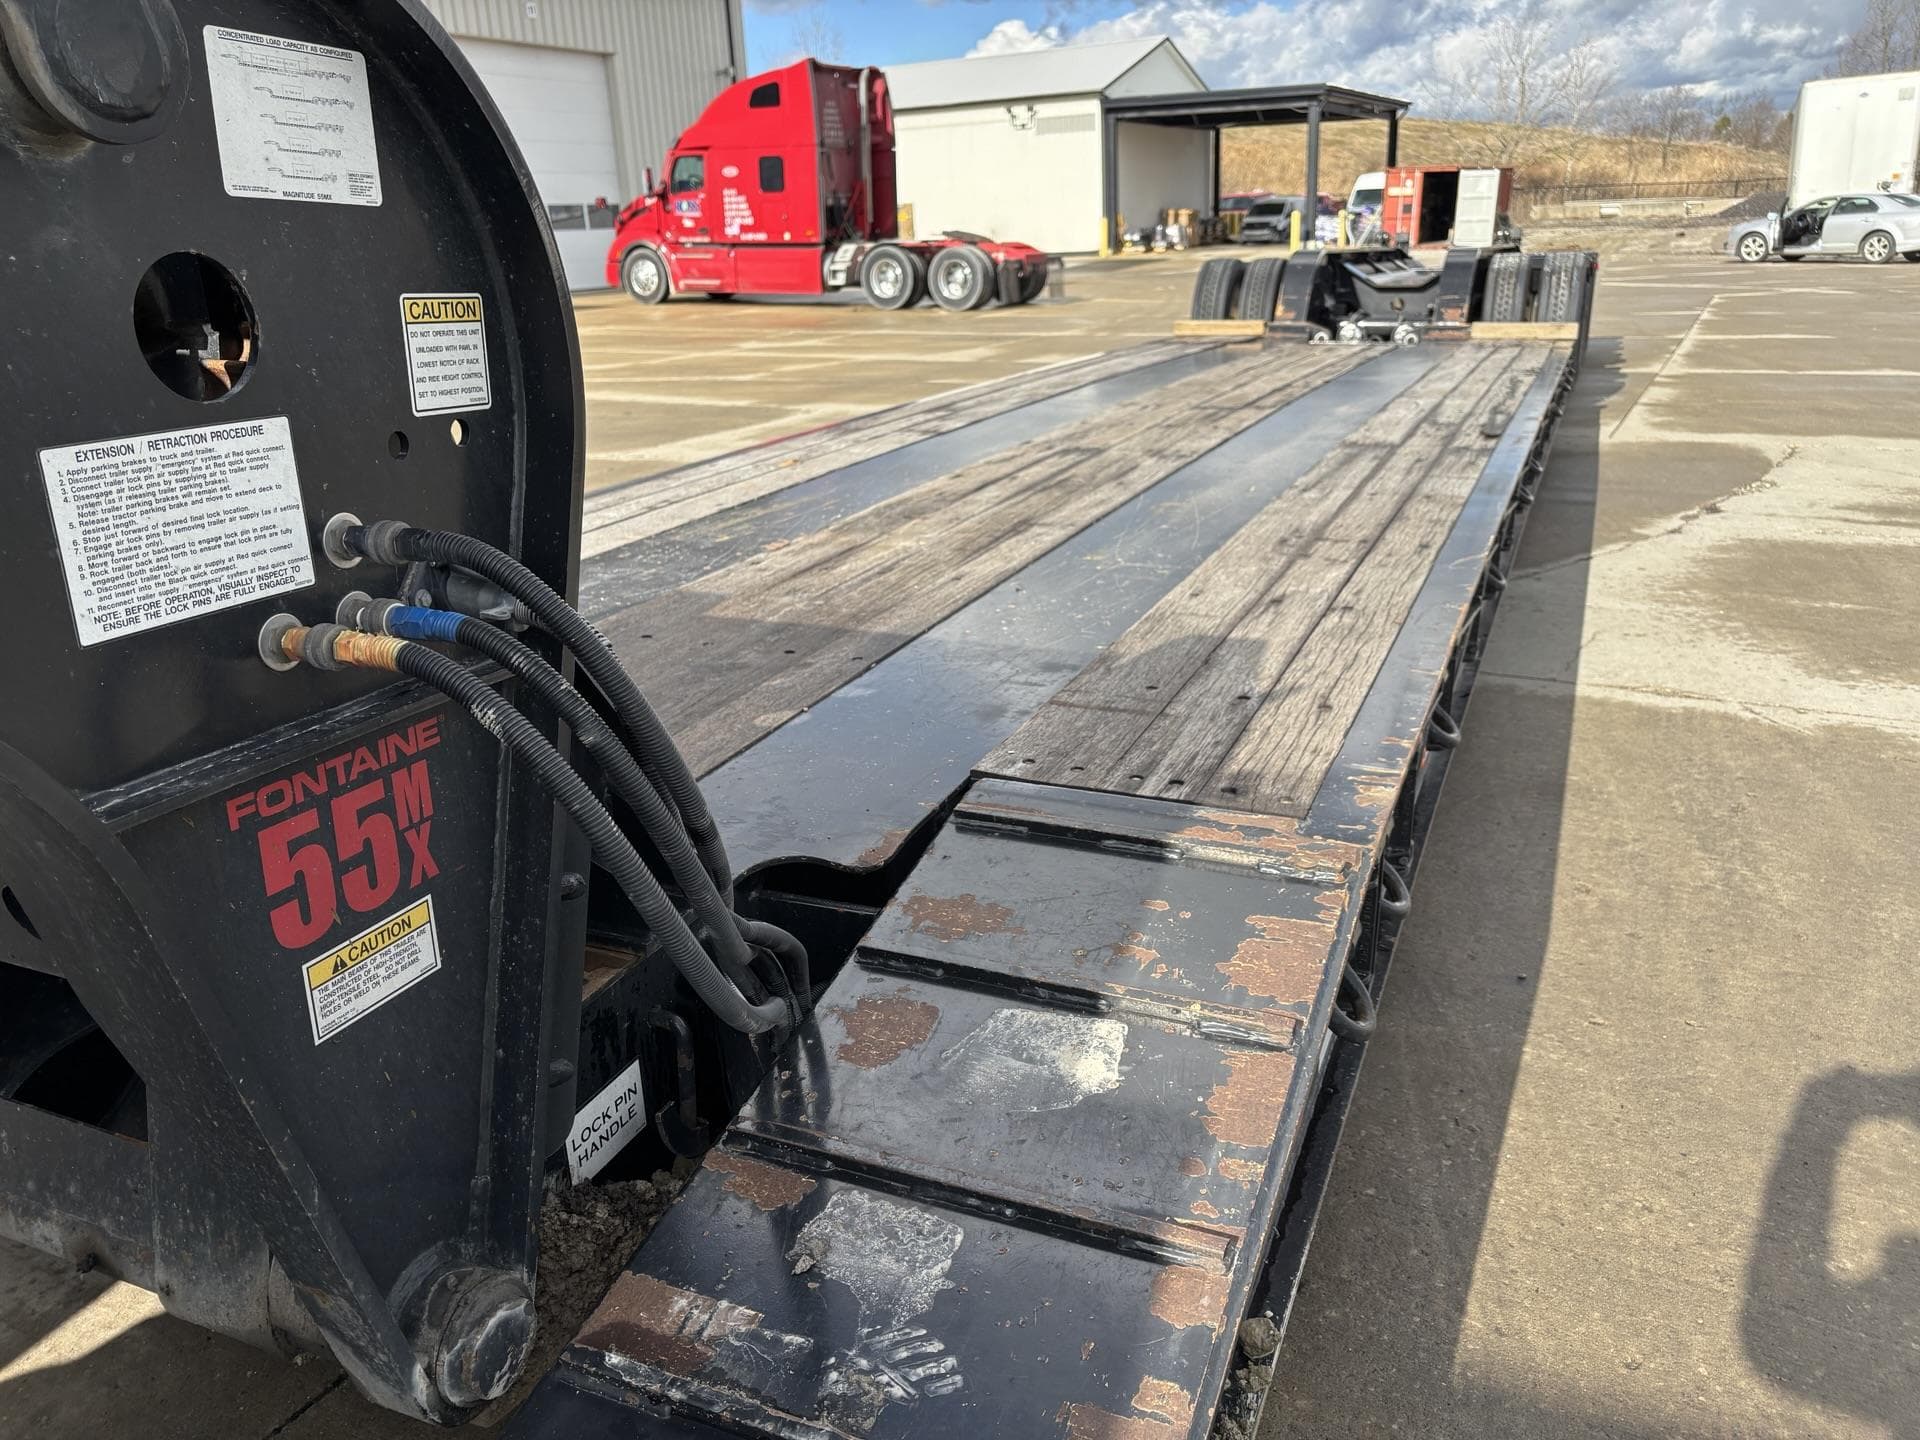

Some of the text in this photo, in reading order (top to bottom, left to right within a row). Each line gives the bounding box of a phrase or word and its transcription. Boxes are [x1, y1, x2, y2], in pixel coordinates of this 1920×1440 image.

[217, 29, 264, 43] CONCENTRATED
[265, 37, 281, 46] LOAD
[282, 40, 308, 50] CAPACITY
[318, 46, 352, 58] CONFIGURED
[282, 190, 315, 199] MAGNITUDE
[408, 301, 476, 319] CAUTION
[409, 330, 418, 338] DO
[431, 329, 455, 337] OPERATE
[455, 328, 467, 336] THIS
[415, 345, 443, 353] UNLOADED
[444, 344, 457, 352] WITH
[416, 360, 438, 368] LOWEST
[439, 359, 456, 367] NOTCH
[457, 358, 465, 366] OF
[427, 375, 440, 383] RIDE
[441, 373, 459, 381] HEIGHT
[460, 372, 484, 380] CONTROL
[418, 391, 428, 399] SET
[438, 388, 459, 396] HIGHEST
[74, 443, 135, 463] EXTENSION
[147, 432, 207, 452] RETRACTION
[209, 424, 264, 442] PROCEDURE
[57, 470, 64, 478] 1.
[66, 466, 88, 476] Apply
[90, 462, 119, 473] parking
[121, 458, 147, 467] brakes
[159, 452, 178, 461] truck
[180, 449, 193, 458] and
[72, 490, 113, 502] Disengage
[115, 486, 125, 494] air
[127, 482, 144, 492] lock
[145, 481, 161, 490] pins
[174, 473, 207, 483] supplying
[209, 470, 217, 478] air
[219, 469, 227, 477] to
[228, 466, 247, 474] trailer
[249, 462, 269, 471] supply
[68, 521, 76, 529] 5.
[78, 517, 109, 528] Release
[111, 511, 137, 521] tractor
[139, 505, 166, 517] parking
[168, 501, 188, 510] brake
[190, 497, 203, 505] and
[205, 494, 223, 502] move
[234, 487, 256, 497] extend
[258, 484, 273, 493] deck
[77, 508, 99, 519] Note:
[100, 505, 123, 514] trailer
[125, 499, 153, 511] parking
[154, 494, 179, 504] brakes
[181, 491, 193, 499] will
[194, 487, 217, 496] remain
[72, 539, 80, 547] 6.
[82, 536, 101, 544] Stop
[103, 531, 118, 541] just
[120, 524, 149, 536] forward
[151, 522, 159, 530] of
[161, 516, 188, 528] desired
[189, 513, 205, 522] final
[206, 510, 221, 519] lock
[81, 523, 110, 536] desired
[77, 564, 86, 572] 8.
[87, 560, 109, 569] Move
[110, 552, 139, 564] forward
[151, 541, 186, 555] backward
[197, 535, 222, 545] engage
[223, 531, 239, 539] lock
[239, 528, 250, 537] pin
[86, 549, 114, 562] parking
[116, 544, 142, 554] brakes
[91, 572, 125, 586] engaged
[126, 568, 146, 579] (both
[93, 610, 122, 624] NOTE:
[124, 599, 162, 617] BEFORE
[217, 576, 255, 594] VISUALLY
[255, 567, 289, 584] INSPECT
[289, 565, 300, 576] TO
[98, 592, 112, 602] and
[114, 587, 136, 598] insert
[137, 584, 152, 592] into
[154, 580, 166, 588] the
[167, 575, 188, 585] Black
[189, 570, 208, 580] quick
[102, 614, 141, 632] ENSURE
[143, 609, 162, 621] THE
[164, 602, 190, 616] LOCK
[192, 596, 212, 608] PINS
[214, 591, 231, 603] ARE
[233, 584, 256, 597] FULLY
[226, 719, 441, 832] FONTAINE
[347, 915, 411, 963] CAUTION
[317, 927, 426, 995] THE MAIN BEAMS OF THIS TRAILER ARE
[318, 973, 362, 1004] CONSTRUCTED
[363, 967, 372, 977] OF
[319, 982, 361, 1013] HIGH-TENSILE
[384, 963, 394, 973] DO
[394, 955, 406, 967] NOT
[406, 947, 422, 961] DRILL
[320, 1002, 342, 1020] HOLES
[342, 996, 352, 1006] OR
[353, 985, 370, 1000] WELD
[371, 979, 381, 989] ON
[381, 967, 399, 983] THESE
[572, 1083, 638, 1152] LOCK PIN
[578, 1104, 637, 1167] HANDLE
